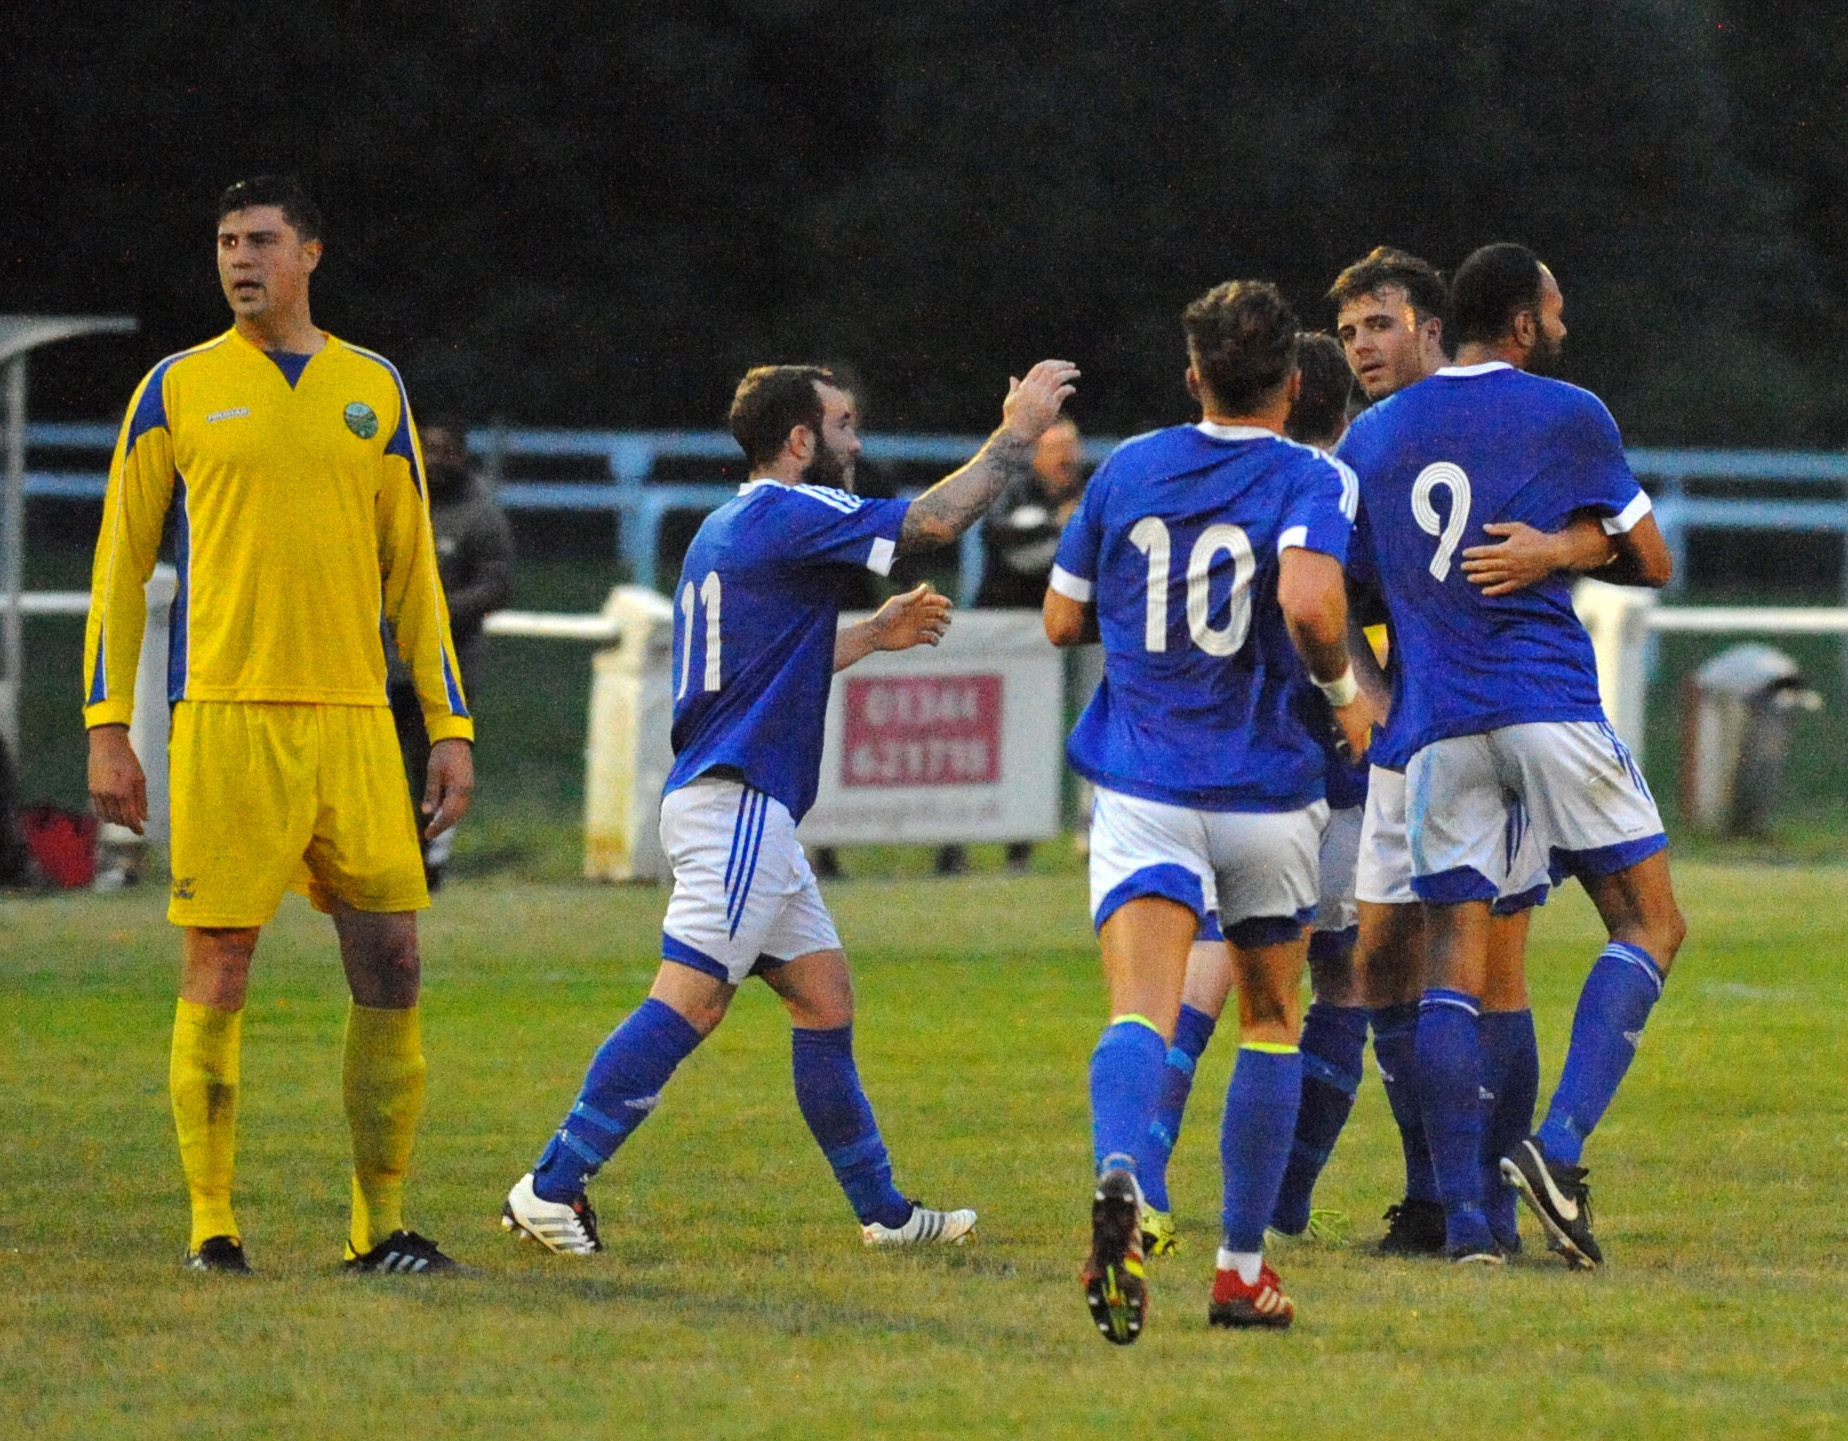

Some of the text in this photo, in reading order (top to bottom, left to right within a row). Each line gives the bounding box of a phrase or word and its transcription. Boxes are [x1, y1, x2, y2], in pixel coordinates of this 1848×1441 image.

[1128, 515, 1257, 657] 10
[1410, 460, 1472, 583] 9
[676, 570, 722, 701] 11
